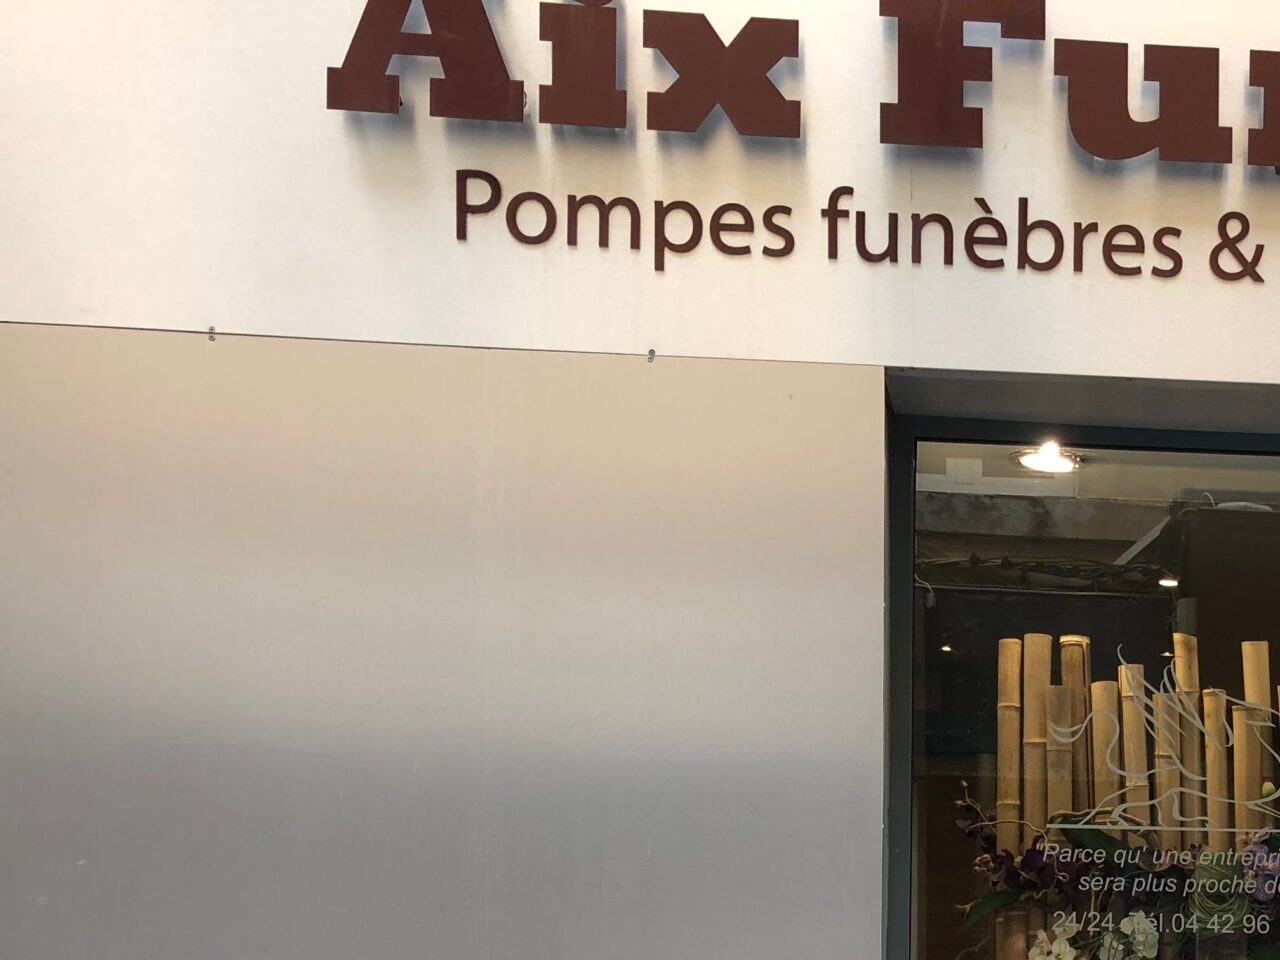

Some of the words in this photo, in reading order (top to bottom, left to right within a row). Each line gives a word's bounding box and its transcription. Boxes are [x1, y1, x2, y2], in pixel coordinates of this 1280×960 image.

[327, 0, 802, 139] Aix
[455, 169, 795, 272] Pompes
[821, 186, 1184, 278] funèbres
[1209, 211, 1264, 284] &
[1152, 850, 1192, 865] une
[1078, 875, 1125, 891] sera
[1131, 873, 1178, 896] plus
[1182, 875, 1257, 897] proche
[1052, 911, 1115, 931] 24/24
[1206, 913, 1235, 933] 42
[1242, 914, 1270, 934] 96
